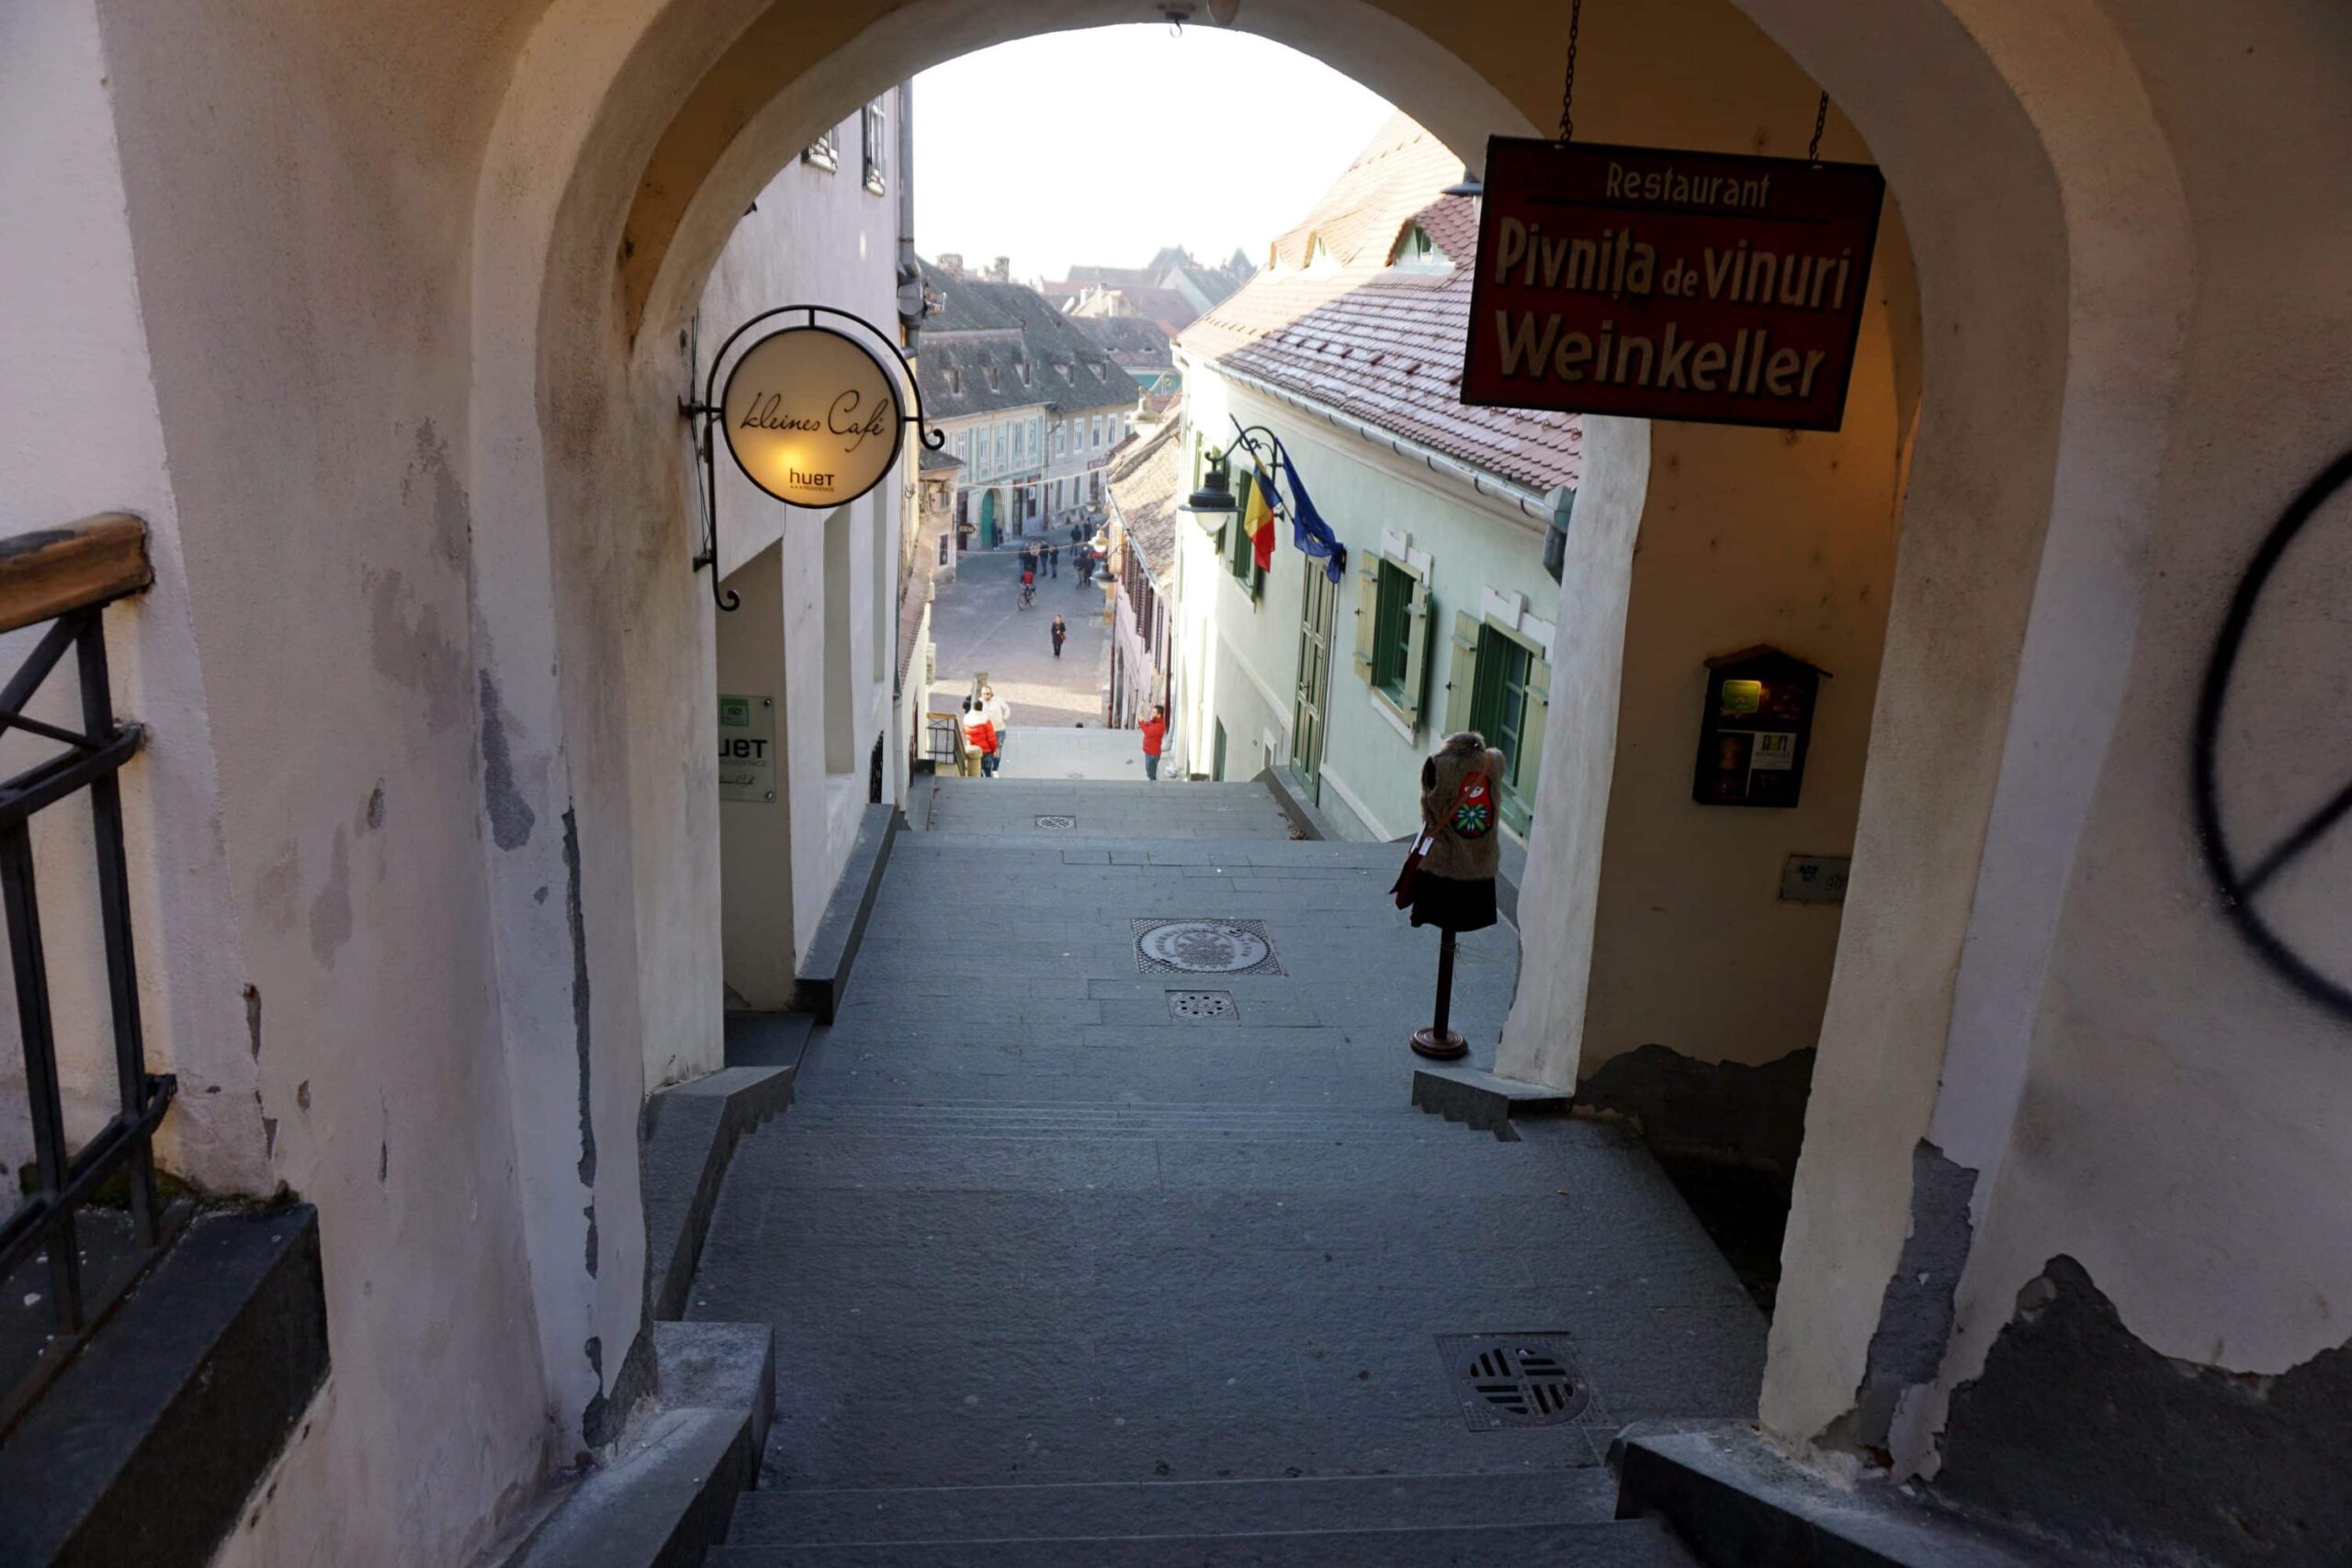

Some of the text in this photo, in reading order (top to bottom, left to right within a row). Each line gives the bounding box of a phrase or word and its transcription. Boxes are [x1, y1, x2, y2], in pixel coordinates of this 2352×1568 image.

[1605, 162, 1770, 209] Restaurant
[1662, 257, 1700, 299] de
[1703, 238, 1852, 311] vinuri
[1494, 309, 1827, 399] Weinkeller
[740, 389, 888, 453] kleines Café
